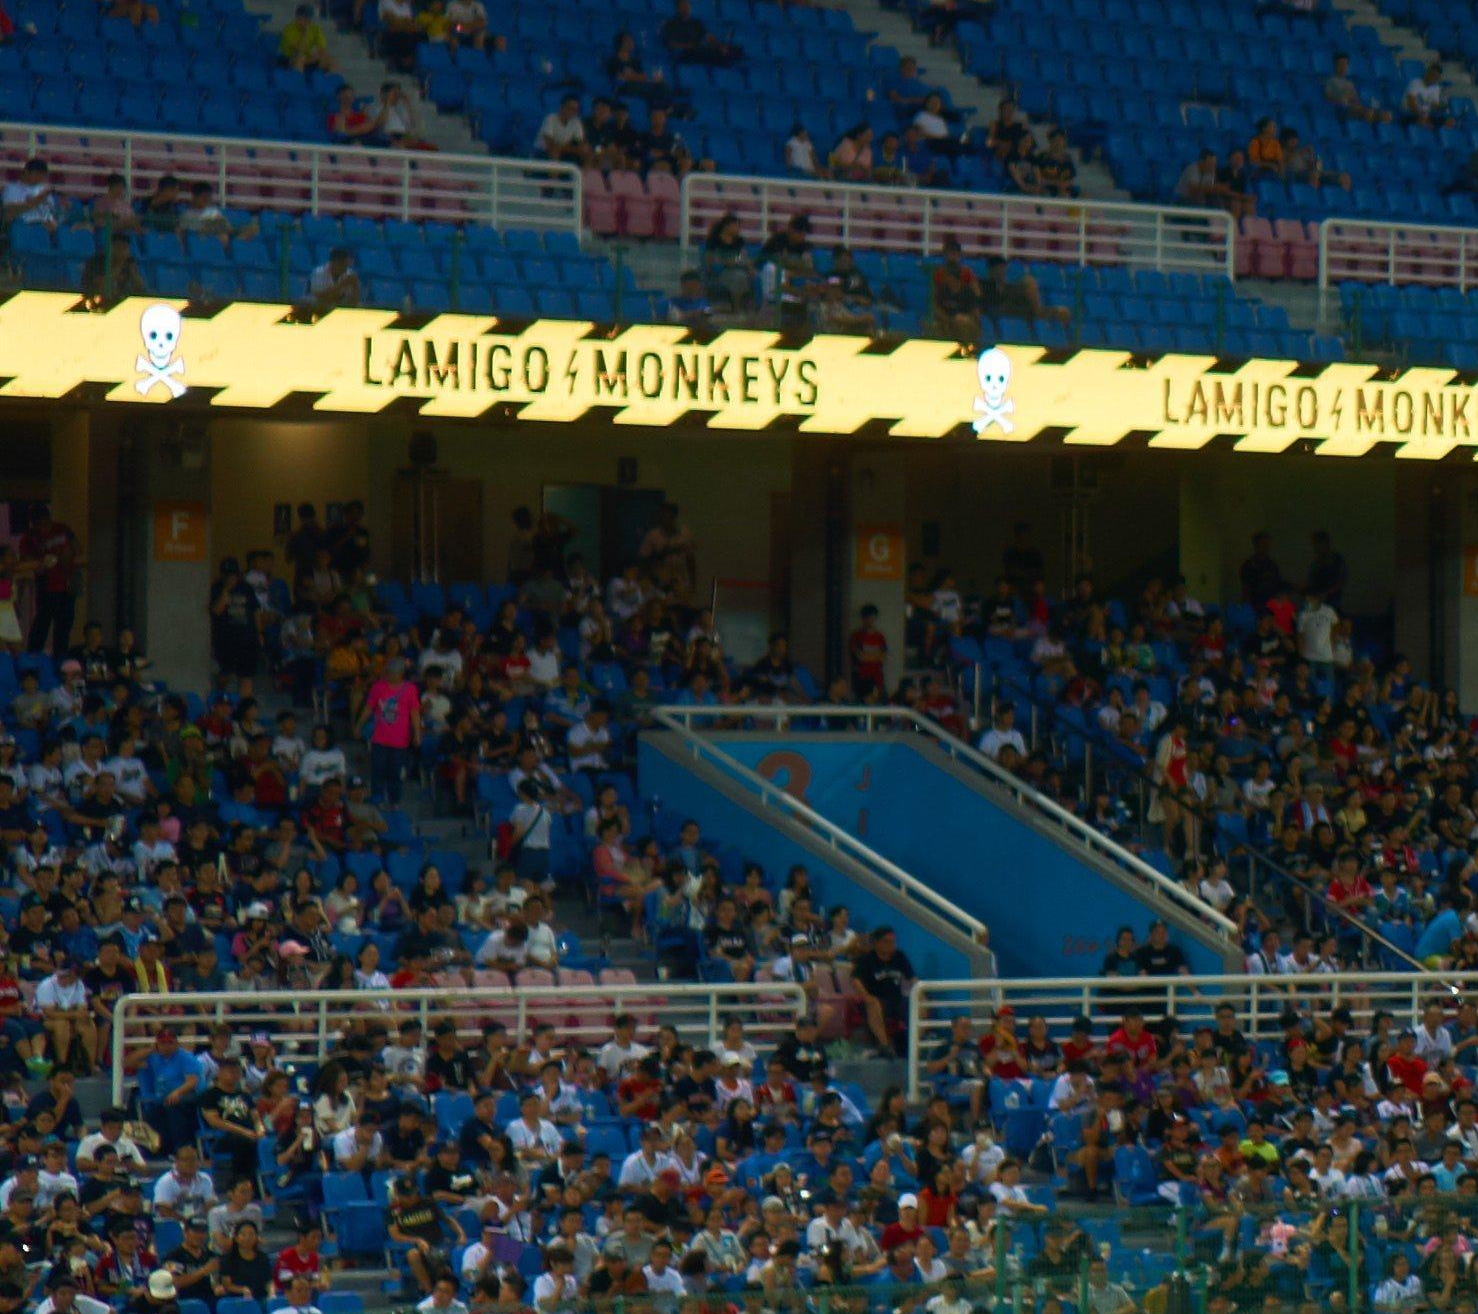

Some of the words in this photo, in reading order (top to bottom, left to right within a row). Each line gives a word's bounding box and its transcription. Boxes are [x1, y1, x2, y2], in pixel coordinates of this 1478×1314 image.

[362, 335, 550, 394] LAMIGO
[595, 348, 819, 406] MONKEYS
[1163, 378, 1318, 429] LAMIGO
[170, 510, 189, 540] F
[868, 532, 890, 561] G
